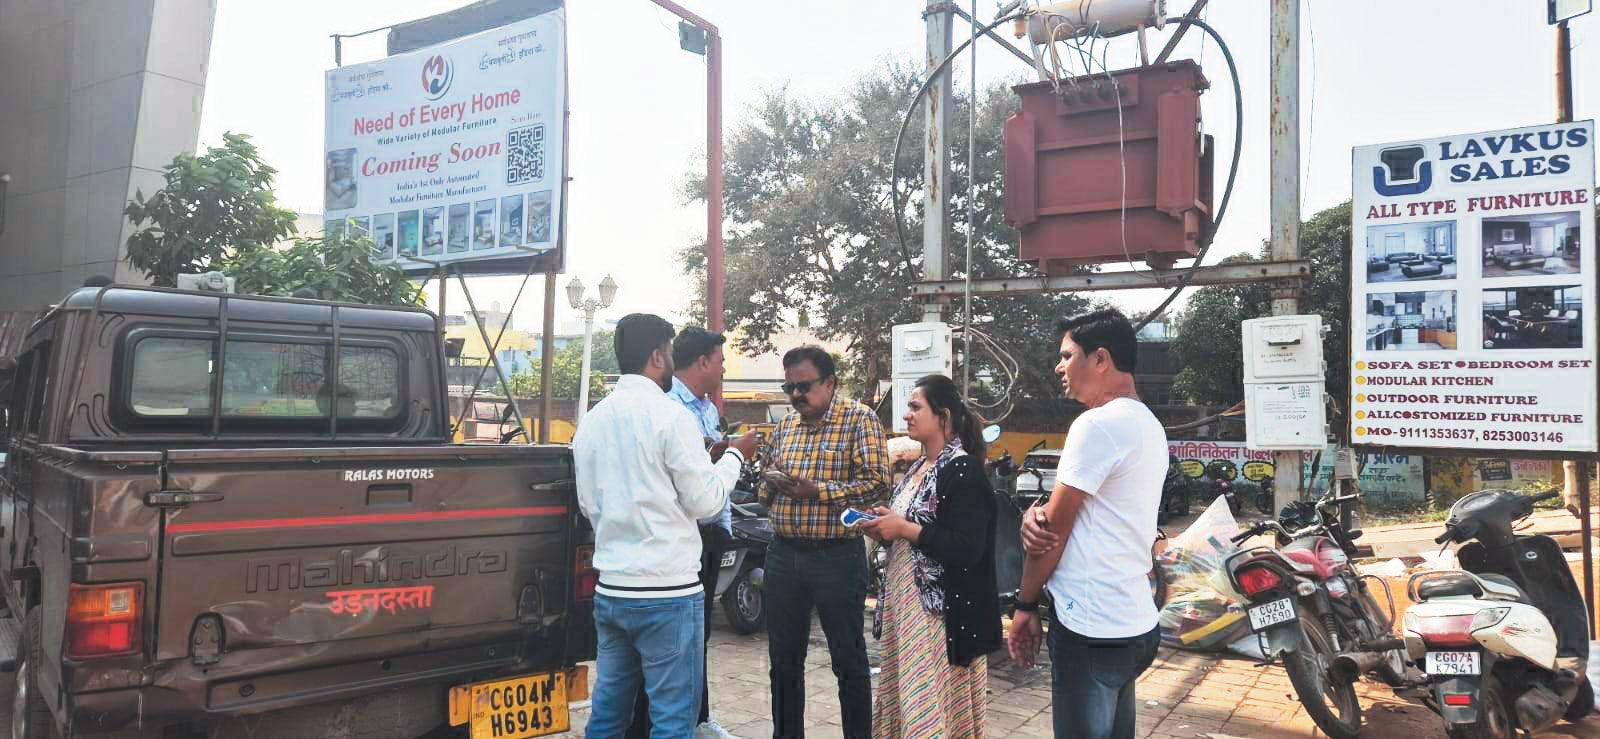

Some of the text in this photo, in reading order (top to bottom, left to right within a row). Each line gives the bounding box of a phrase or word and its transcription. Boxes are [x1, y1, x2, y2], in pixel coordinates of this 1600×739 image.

[353, 88, 521, 136] Need of Every Home
[422, 130, 430, 139] of
[431, 125, 460, 138] Modular
[1439, 127, 1588, 161] LAVKUS
[362, 141, 502, 177] Coming Soon
[1450, 154, 1571, 183] SALES
[1366, 188, 1589, 219] ALL TYPE FURNITURE
[1367, 359, 1593, 370] SOFA SET BEDROOM SET
[1367, 376, 1494, 386] MODULAR KITCHEN
[1366, 394, 1538, 405] OUTDOOR FURNITURE
[1490, 412, 1584, 424] FURNITURE
[1482, 430, 1564, 443] 8253003146
[344, 468, 435, 481] RALAS MOTORS
[245, 546, 509, 593] mahindra
[1259, 600, 1285, 616] CG28
[1435, 652, 1473, 663] CG07A
[1436, 663, 1473, 674] K7941
[490, 705, 553, 737] H6943
